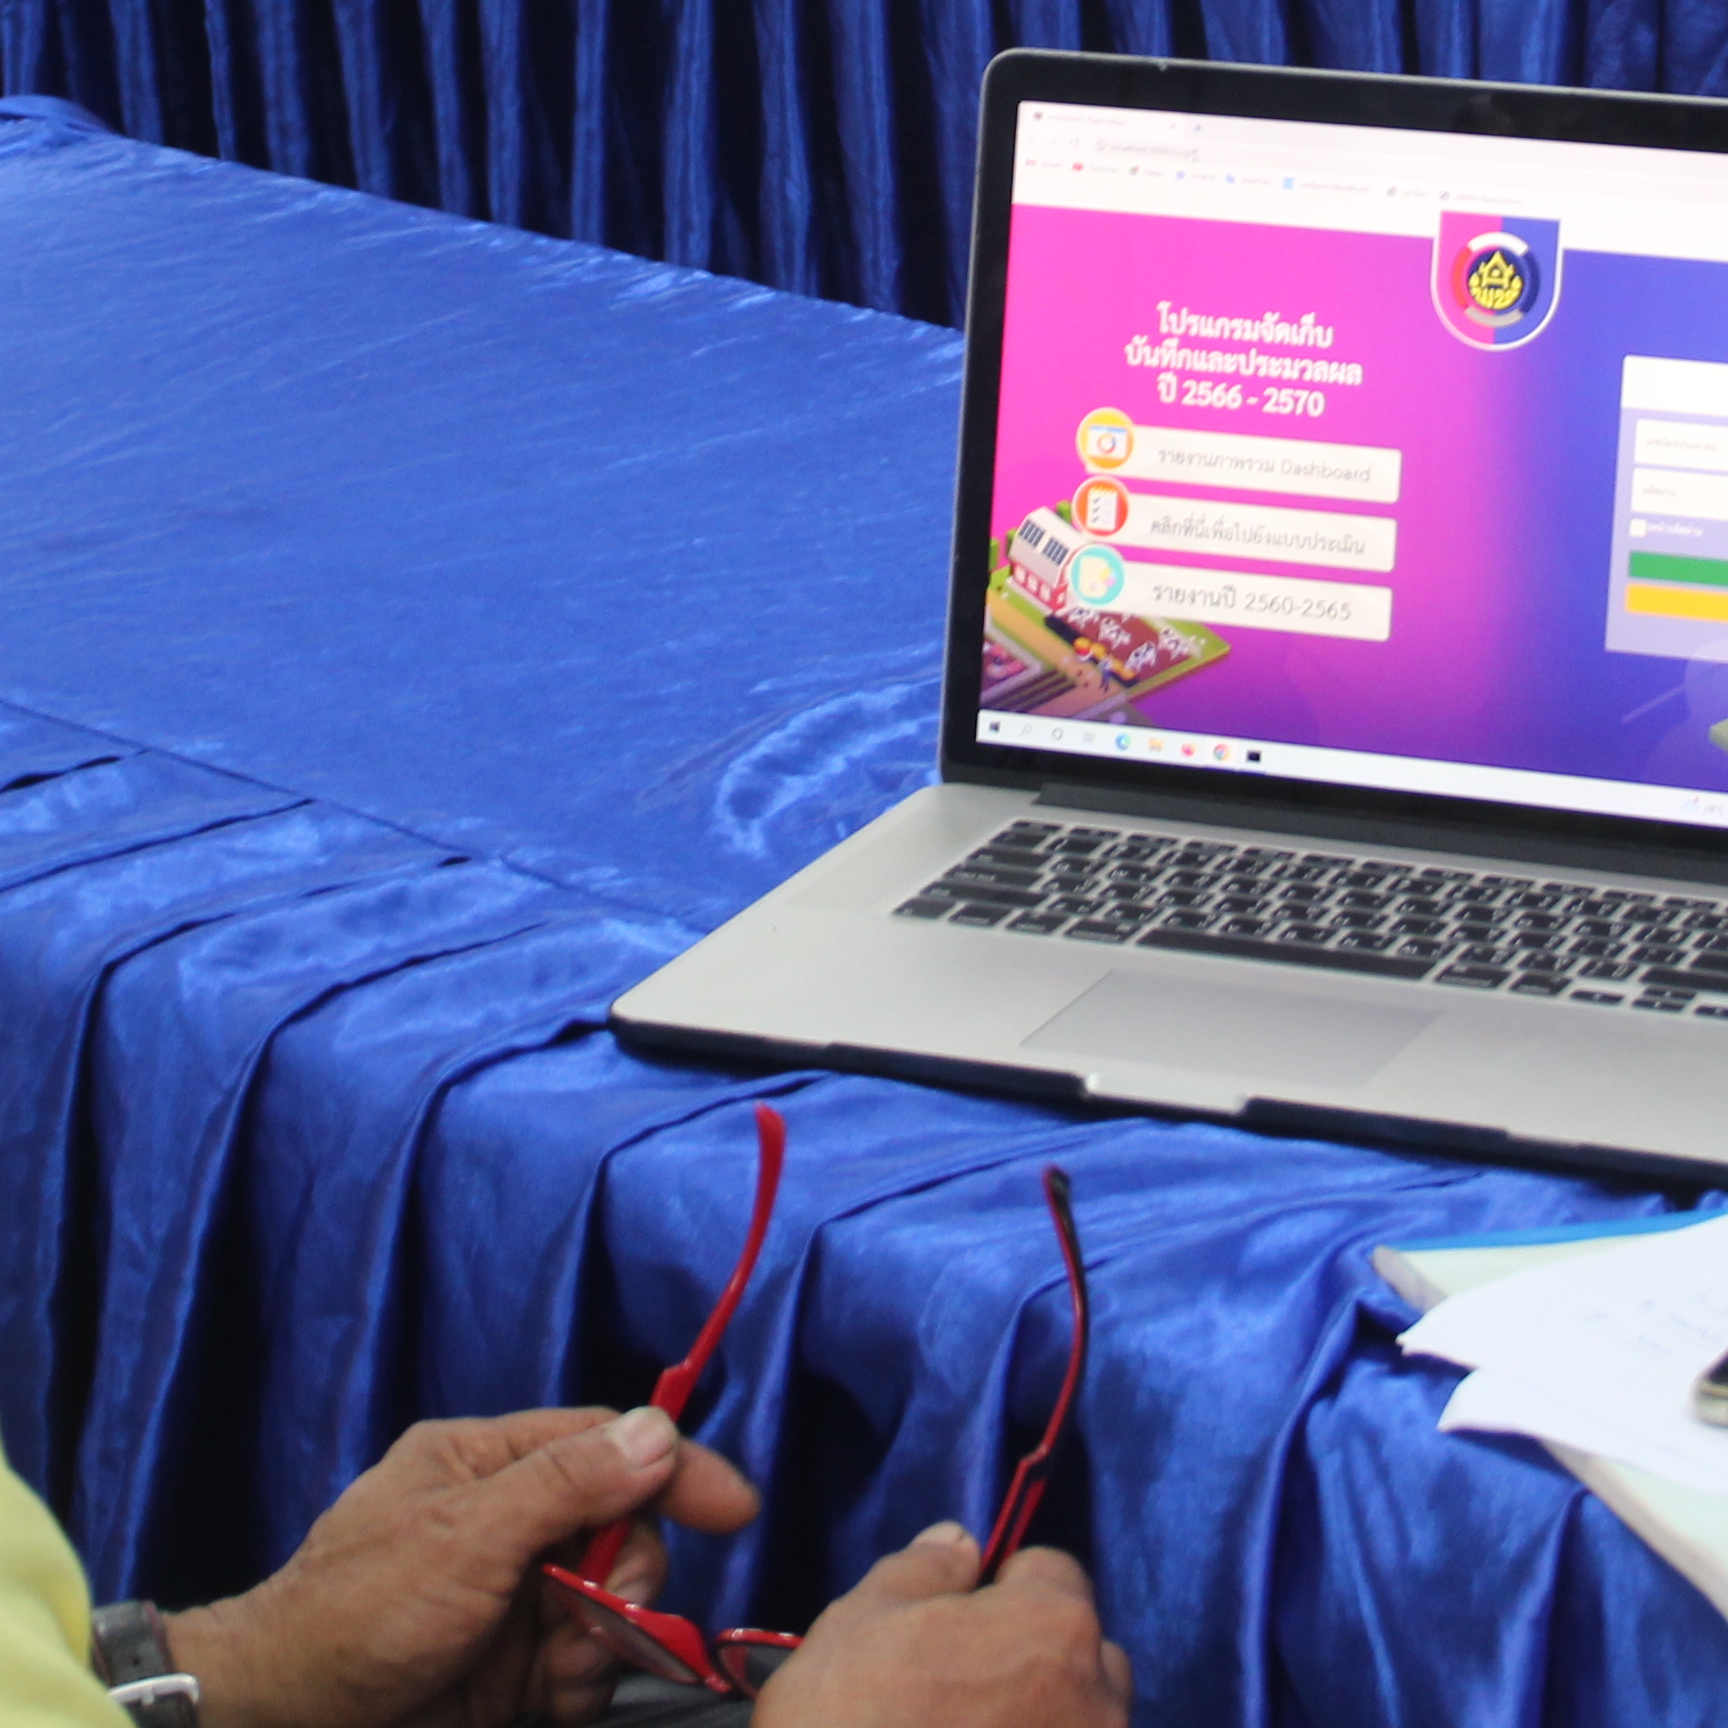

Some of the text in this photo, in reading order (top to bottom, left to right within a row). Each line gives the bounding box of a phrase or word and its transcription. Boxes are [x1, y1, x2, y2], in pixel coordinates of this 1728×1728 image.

[1157, 300, 1334, 349] โปรแกรมจัดเก็บ
[1124, 335, 1364, 386] บันทึกและประมวลผล
[1157, 372, 1178, 404] ปี
[1181, 379, 1243, 409] 2566
[1261, 386, 1326, 417] 2570
[1157, 448, 1372, 483] รายงานภาพรวม Dashboard
[1152, 584, 1353, 622] รายงานปี 2560-2565
